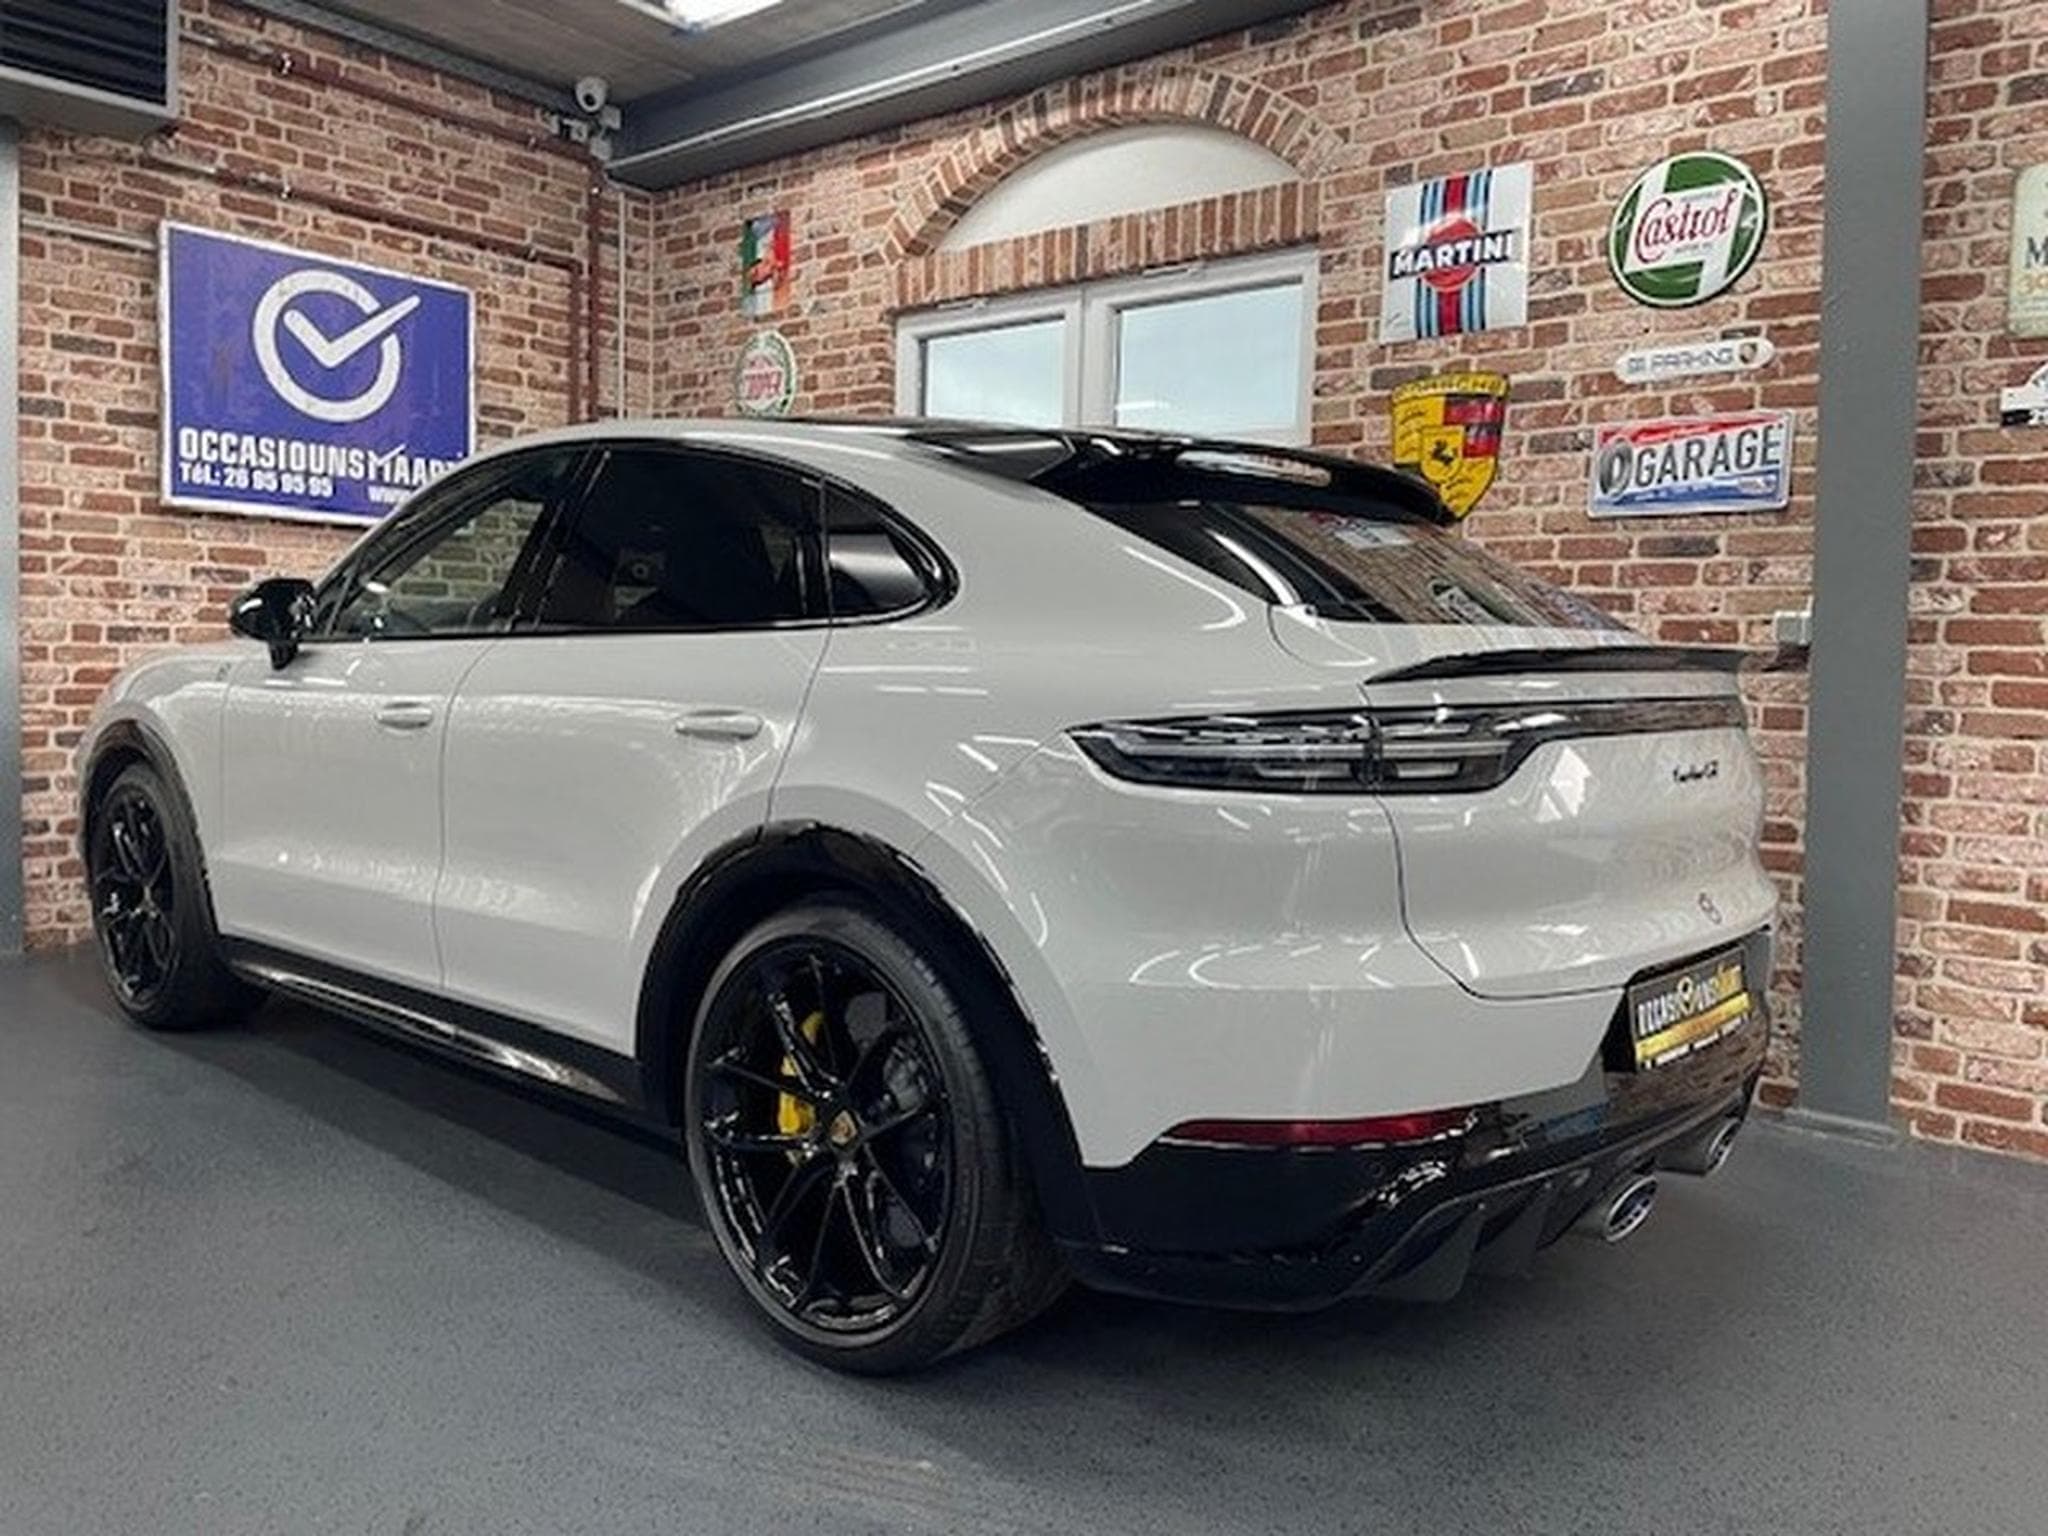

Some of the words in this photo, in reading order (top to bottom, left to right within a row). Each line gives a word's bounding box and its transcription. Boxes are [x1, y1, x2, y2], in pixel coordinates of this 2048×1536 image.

[1393, 233, 1514, 276] MARTINI
[1635, 188, 1738, 264] Castrol
[1635, 424, 1781, 488] GARAGE
